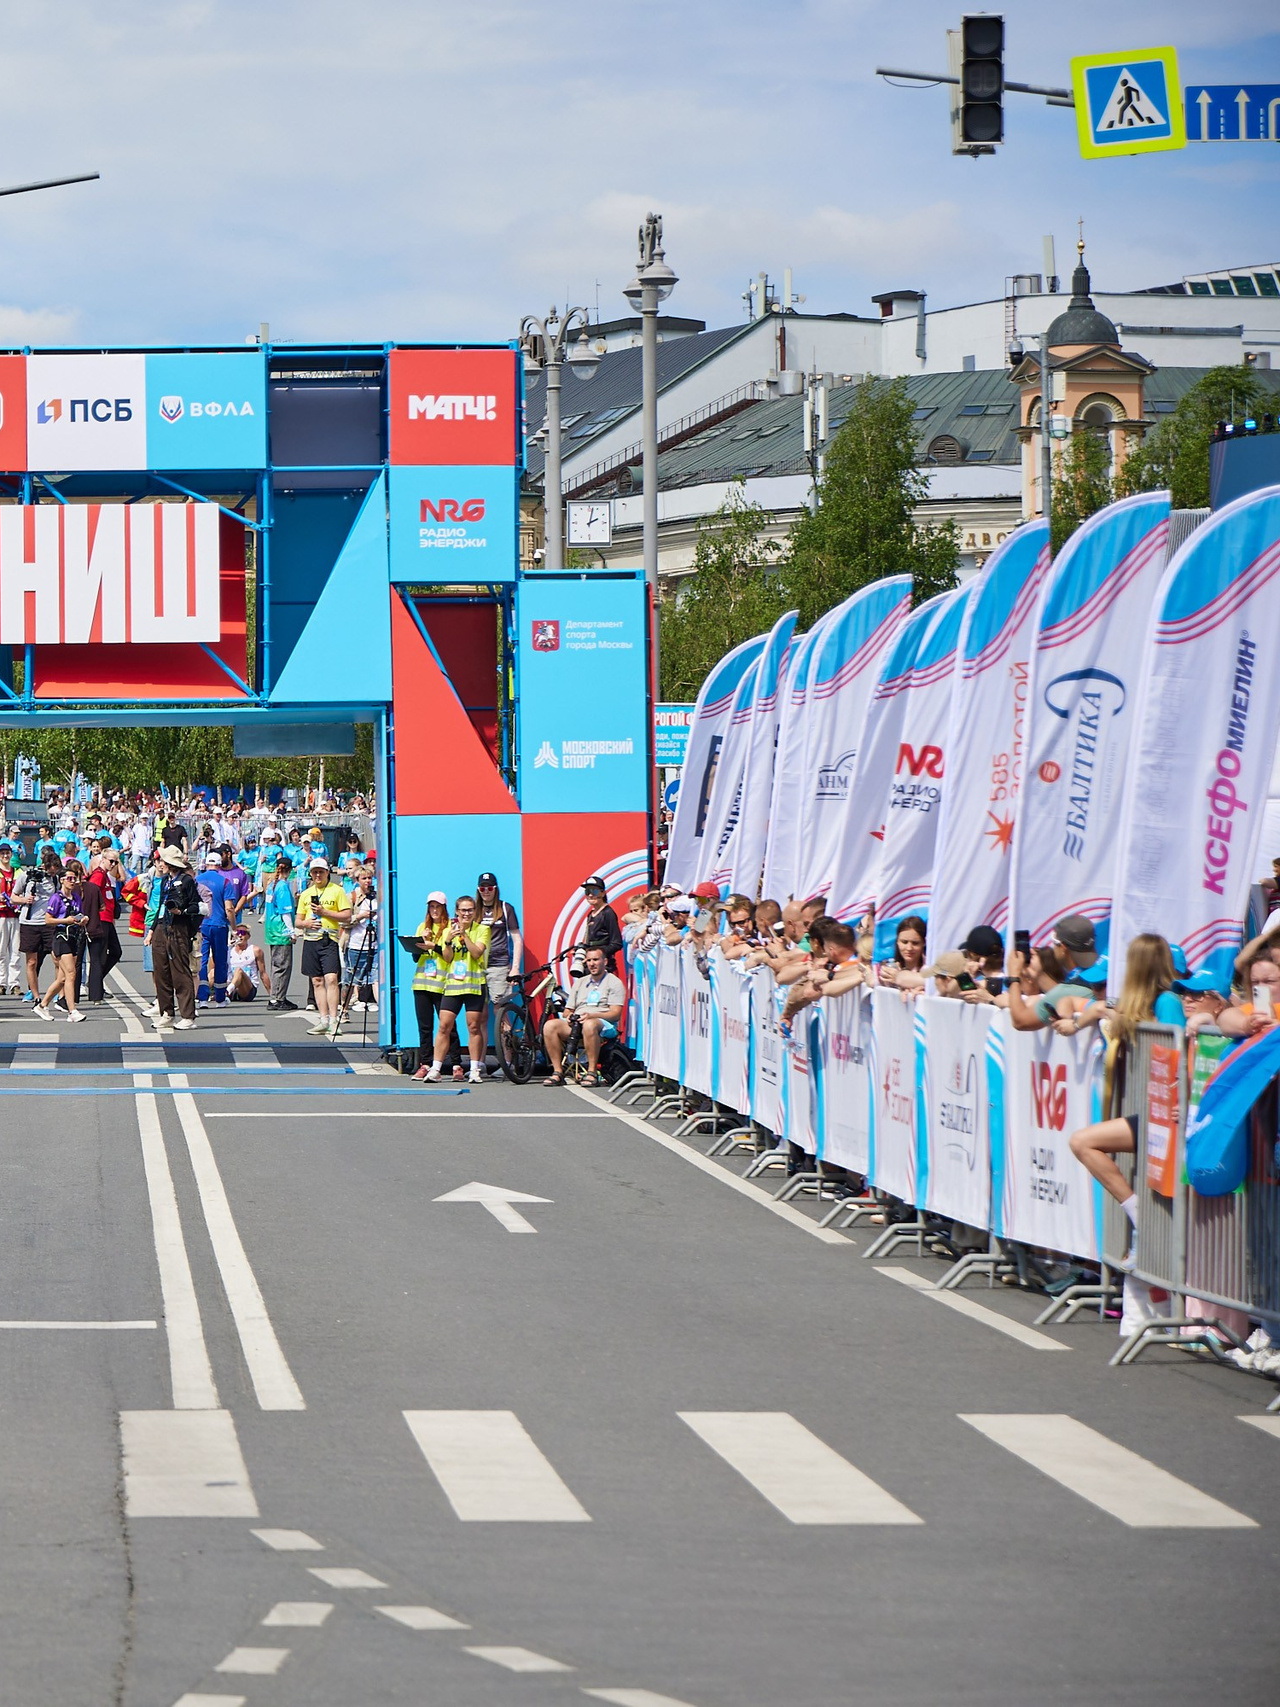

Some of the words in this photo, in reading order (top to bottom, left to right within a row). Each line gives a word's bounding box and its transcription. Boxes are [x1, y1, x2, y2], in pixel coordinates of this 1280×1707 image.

[69, 398, 133, 423] ПСБ
[189, 401, 255, 417] ВФЛА
[408, 394, 497, 421] МАТЧ!
[419, 498, 485, 523] NRG
[419, 528, 466, 538] РАДИО
[965, 532, 1008, 548] ДВО
[419, 538, 487, 549] ЭНЕРДЖИ
[565, 620, 624, 630] Департамент
[566, 632, 596, 641] спорта
[566, 642, 597, 651] города
[598, 641, 633, 649] Москвы
[655, 711, 685, 726] РОГОЙ
[562, 738, 633, 755] МОСКОВСКИЙ
[562, 755, 596, 768] СПОРТ
[894, 742, 946, 780] NR
[1065, 690, 1102, 832] БАЛТИКА
[990, 752, 1010, 802] 585
[1030, 1060, 1067, 1132] NRG
